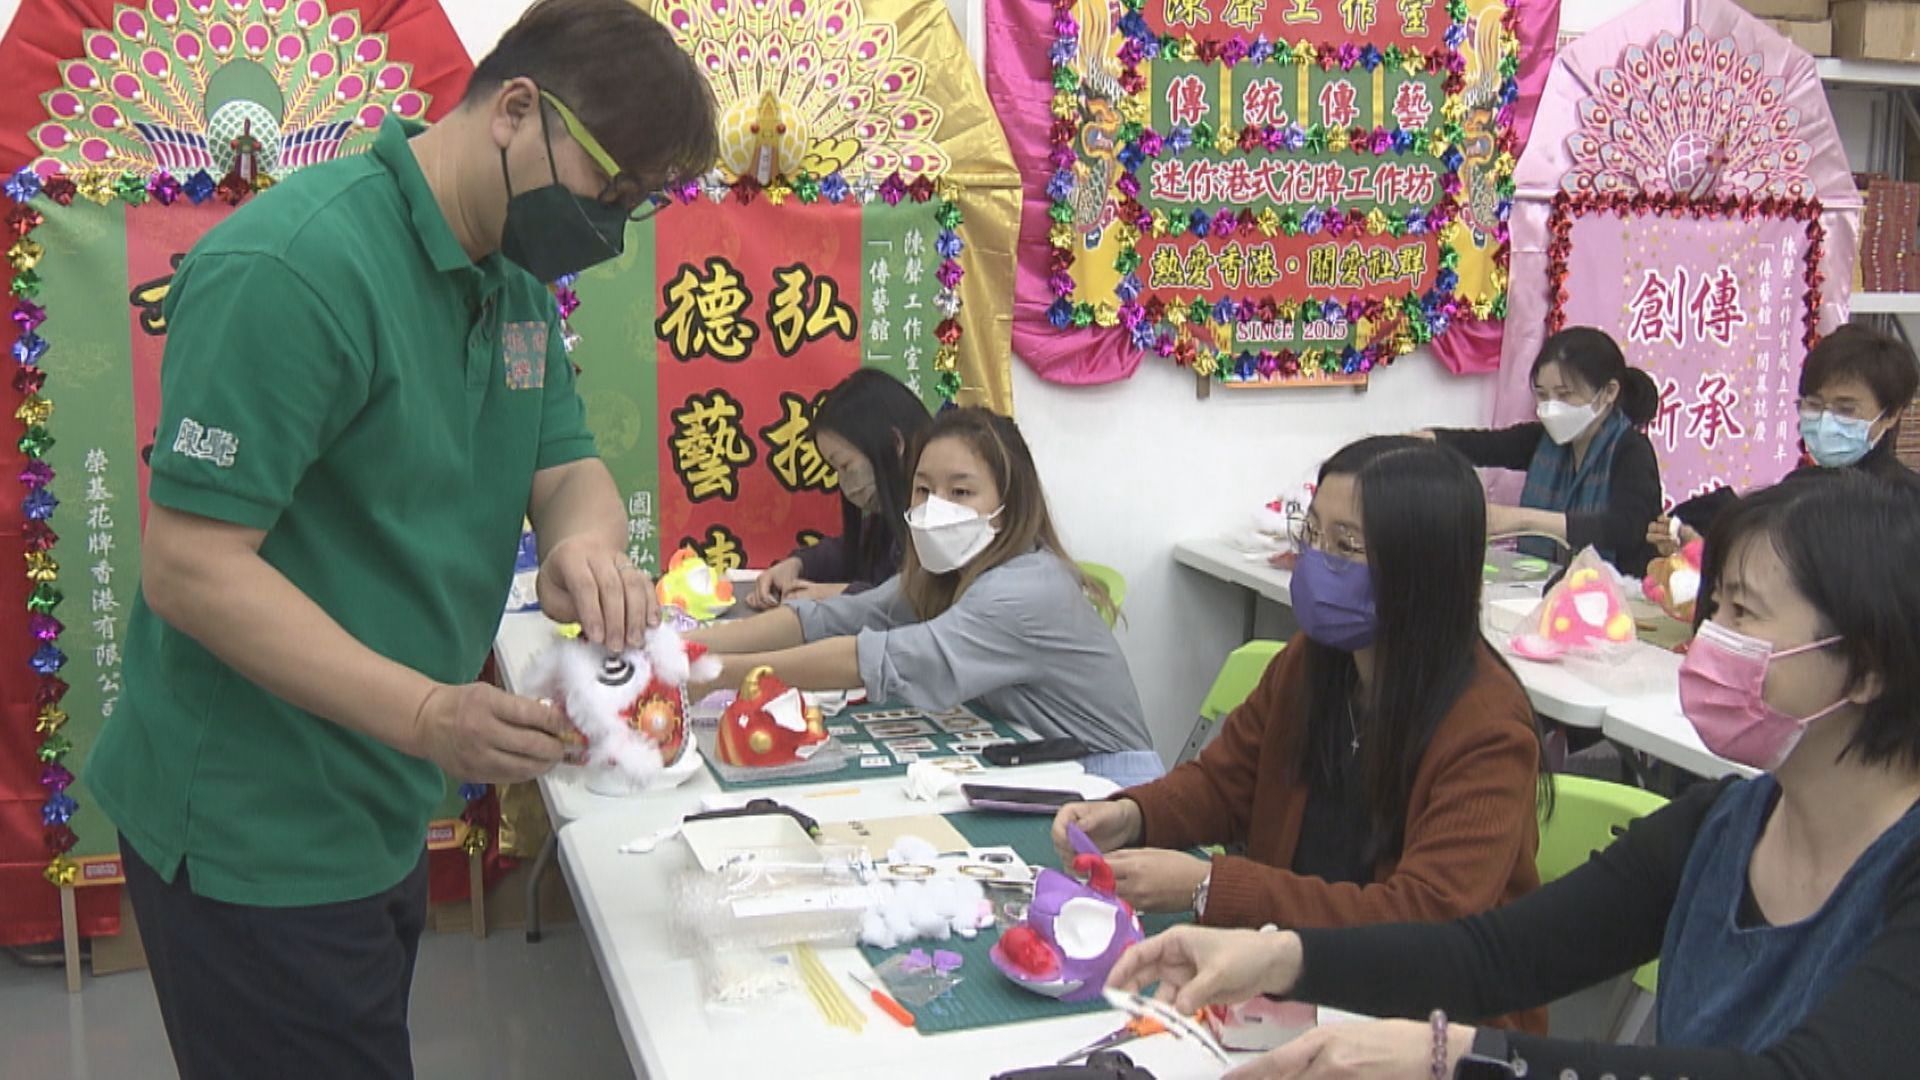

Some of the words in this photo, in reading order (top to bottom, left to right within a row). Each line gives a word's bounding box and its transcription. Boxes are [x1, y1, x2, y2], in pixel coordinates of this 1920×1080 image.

[1167, 75, 1433, 130] 傳統傳藝
[1151, 158, 1435, 203] 迷你港式花牌工作坊
[1236, 320, 1293, 341] SINCE
[1303, 319, 1349, 339] 2015
[761, 259, 860, 546] 弘揚
[628, 491, 655, 576] 國際弘
